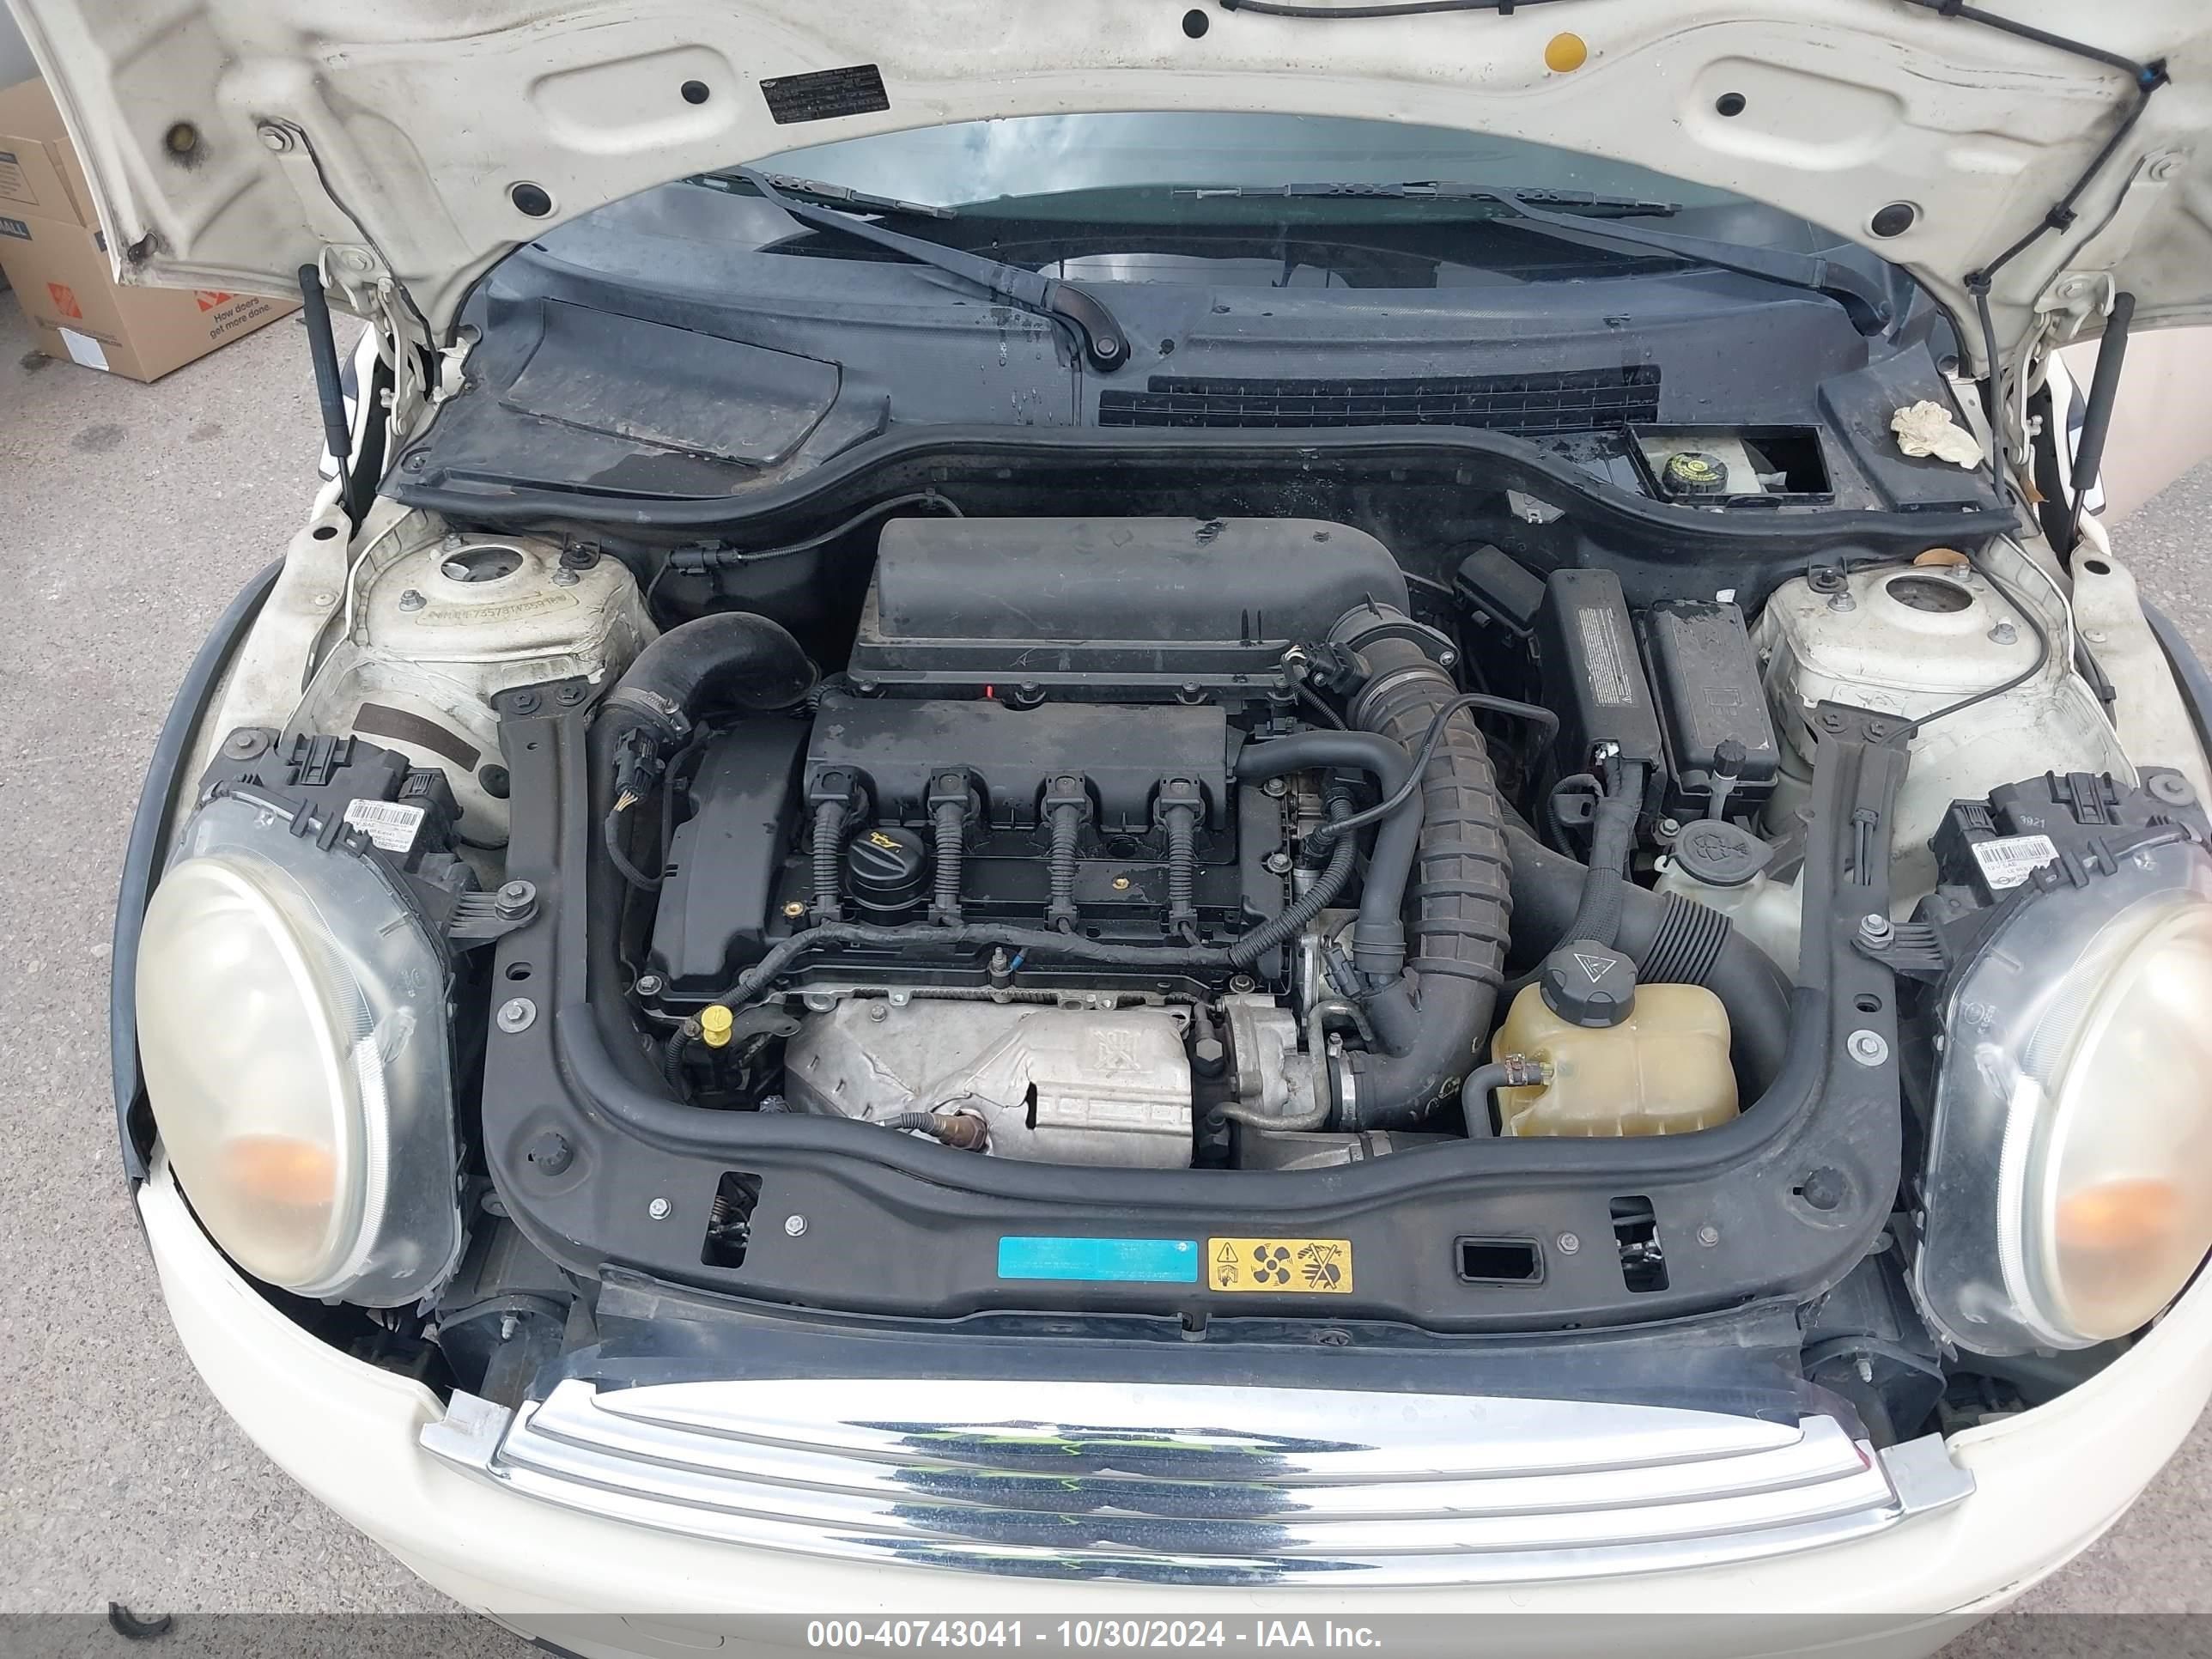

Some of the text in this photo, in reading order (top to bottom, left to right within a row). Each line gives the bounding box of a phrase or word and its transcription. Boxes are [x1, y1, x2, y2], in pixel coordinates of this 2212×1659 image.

[214, 296, 259, 324] How doers
[210, 325, 225, 340] get
[226, 315, 248, 331] more
